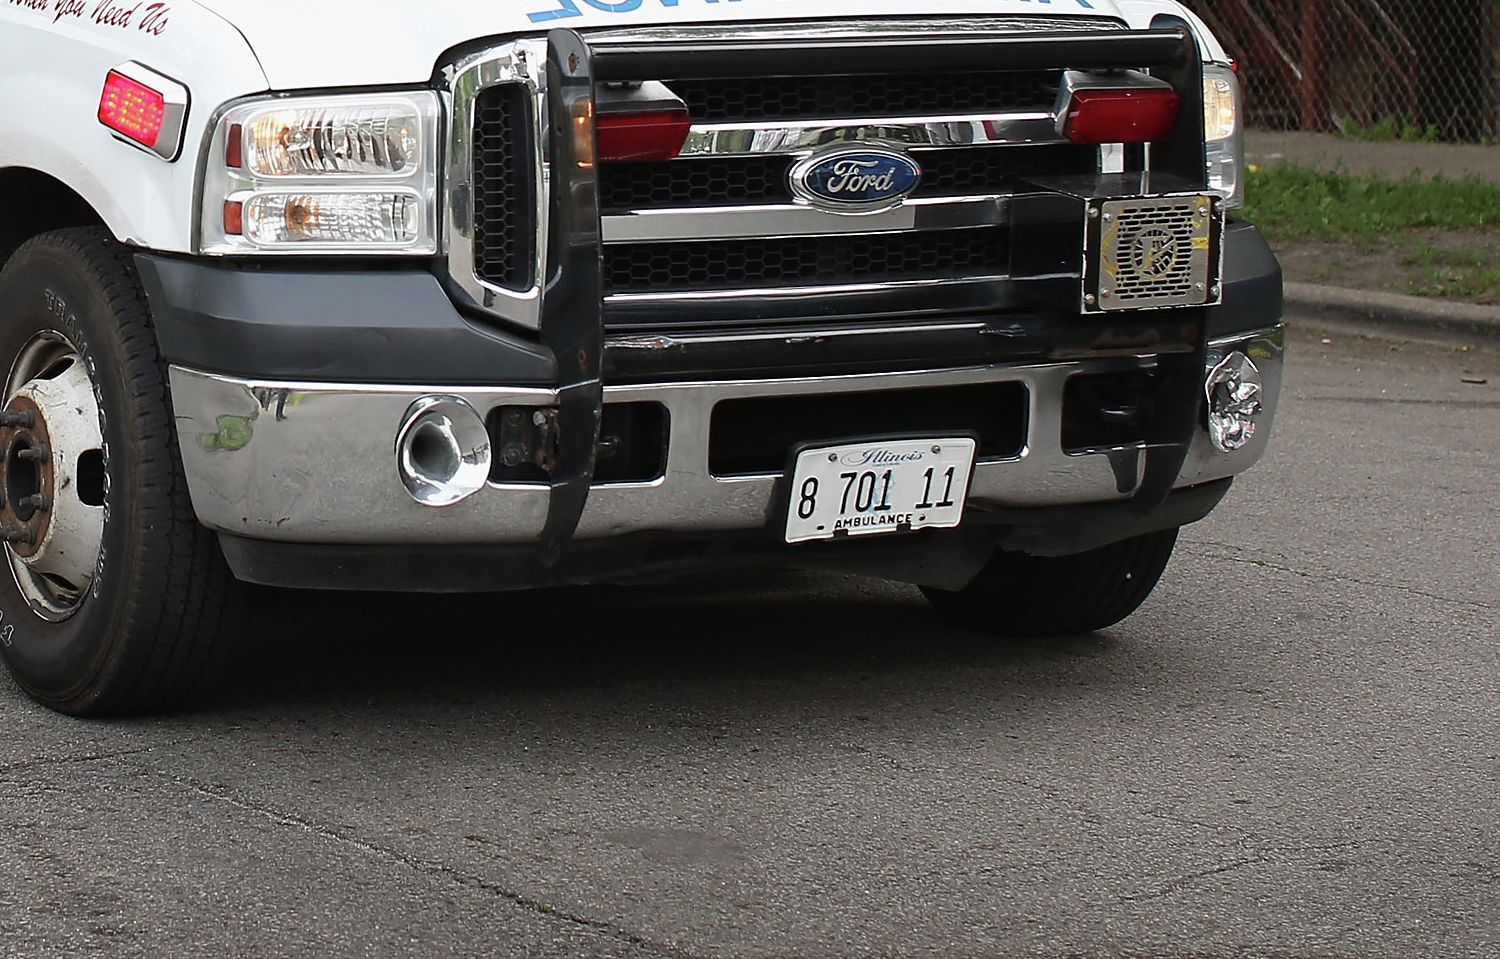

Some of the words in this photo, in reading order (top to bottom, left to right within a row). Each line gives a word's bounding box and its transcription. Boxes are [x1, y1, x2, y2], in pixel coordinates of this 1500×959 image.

[139, 2, 172, 36] Us
[826, 160, 896, 193] Ford
[841, 447, 926, 467] Illinois
[797, 477, 819, 520] 8
[839, 469, 893, 515] 701
[915, 466, 956, 509] 11
[834, 513, 913, 529] AMBULANCE
